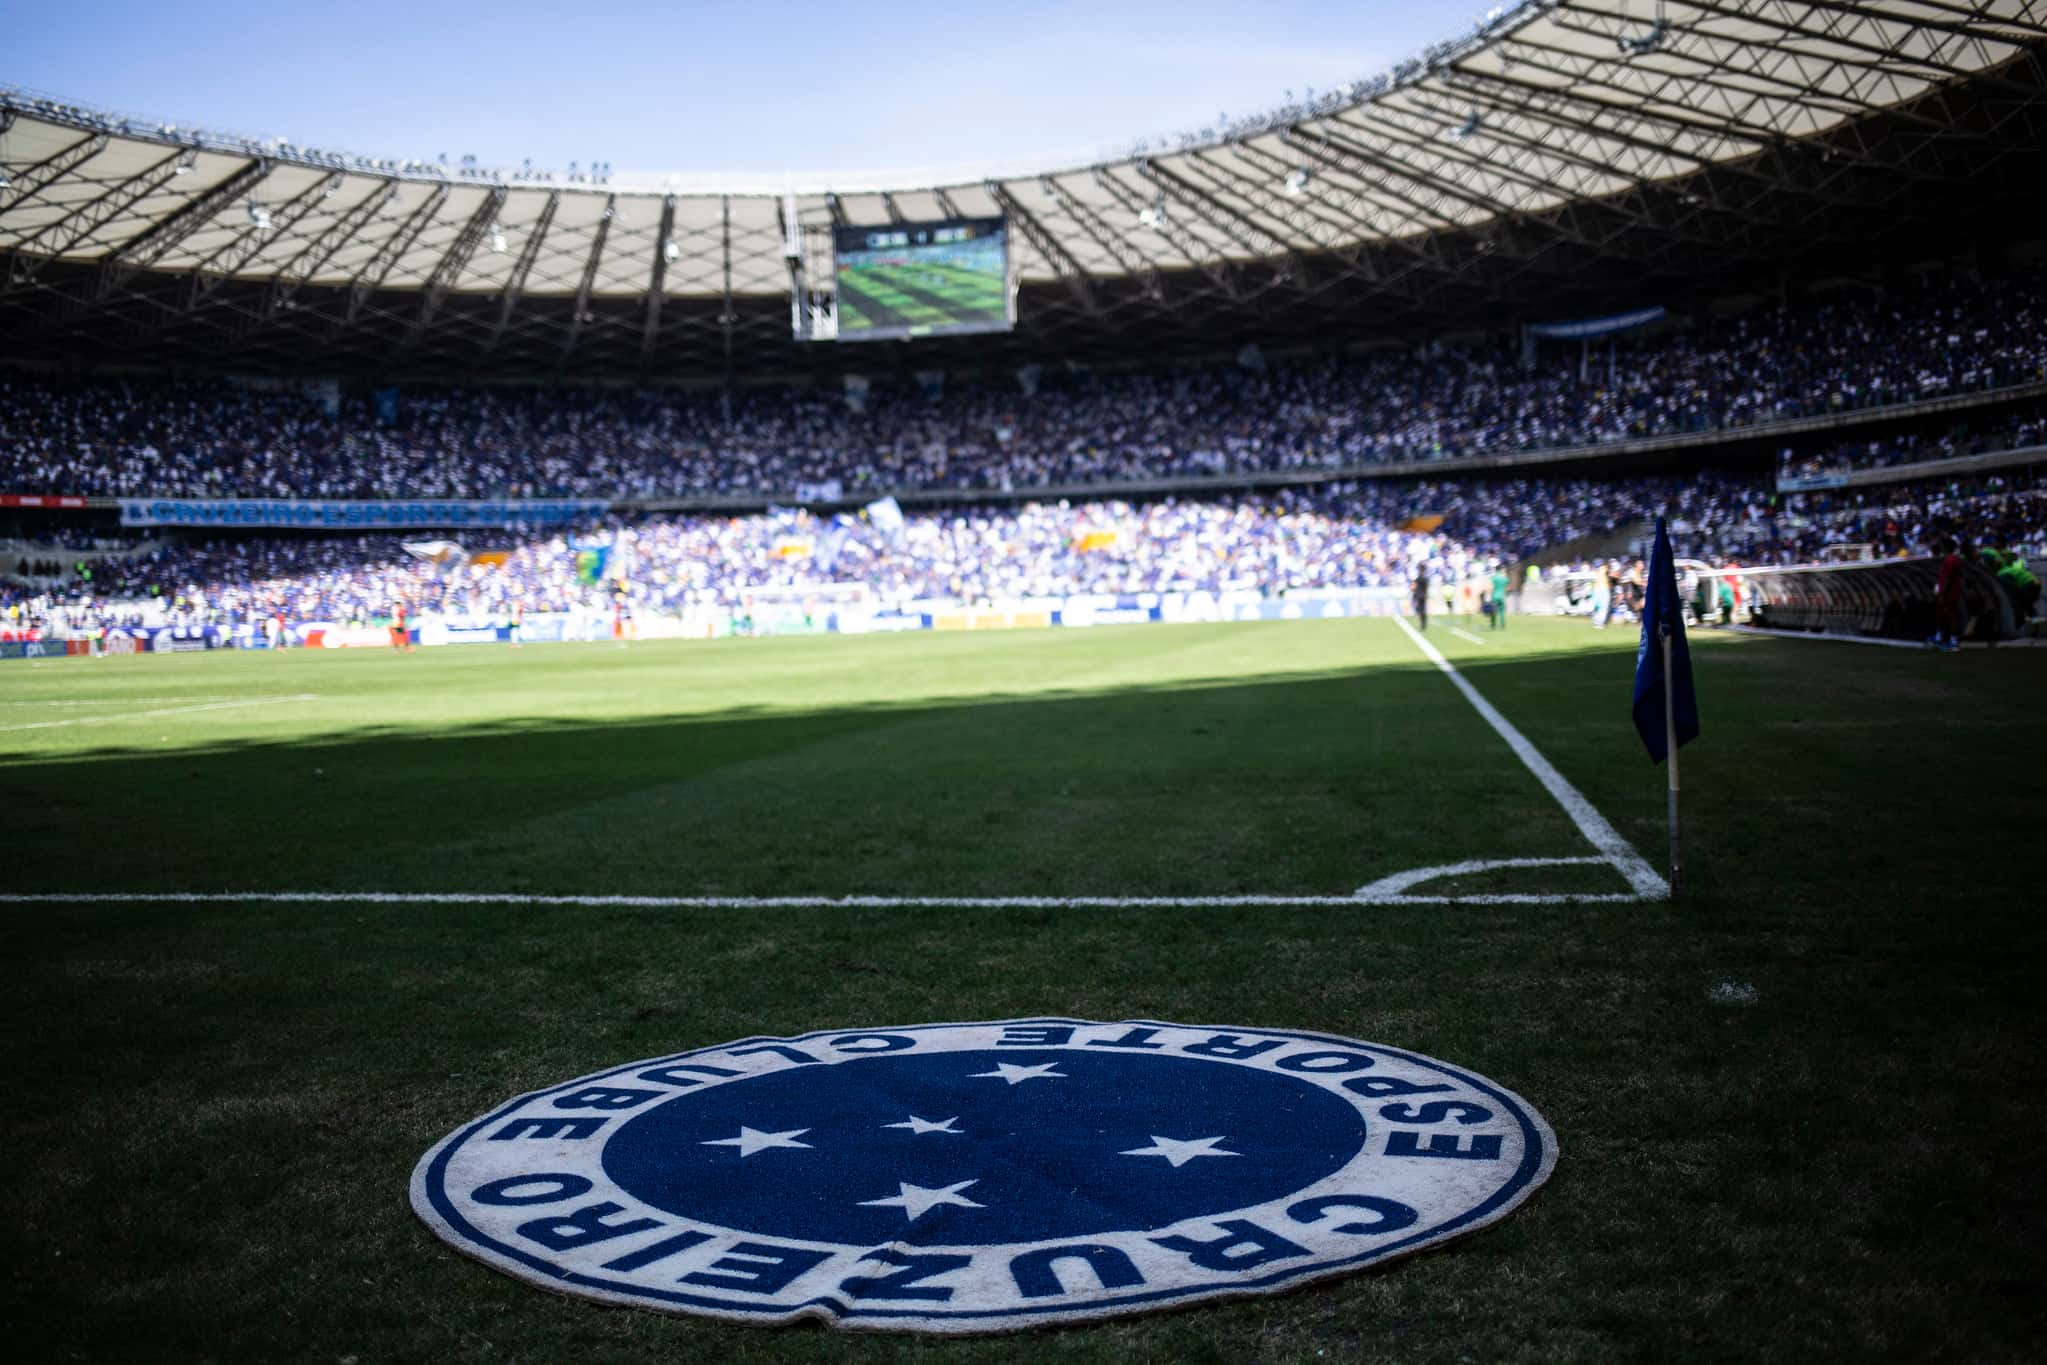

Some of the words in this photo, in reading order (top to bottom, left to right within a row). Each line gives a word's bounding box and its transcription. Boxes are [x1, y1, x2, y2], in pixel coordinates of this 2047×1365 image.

[152, 502, 313, 524] CRUZEIRO
[323, 502, 468, 526] ESPORTE
[487, 1034, 917, 1141] CLUBE
[995, 1026, 1501, 1160] ESPORTE
[470, 1172, 1418, 1301] CRUZEIRO
